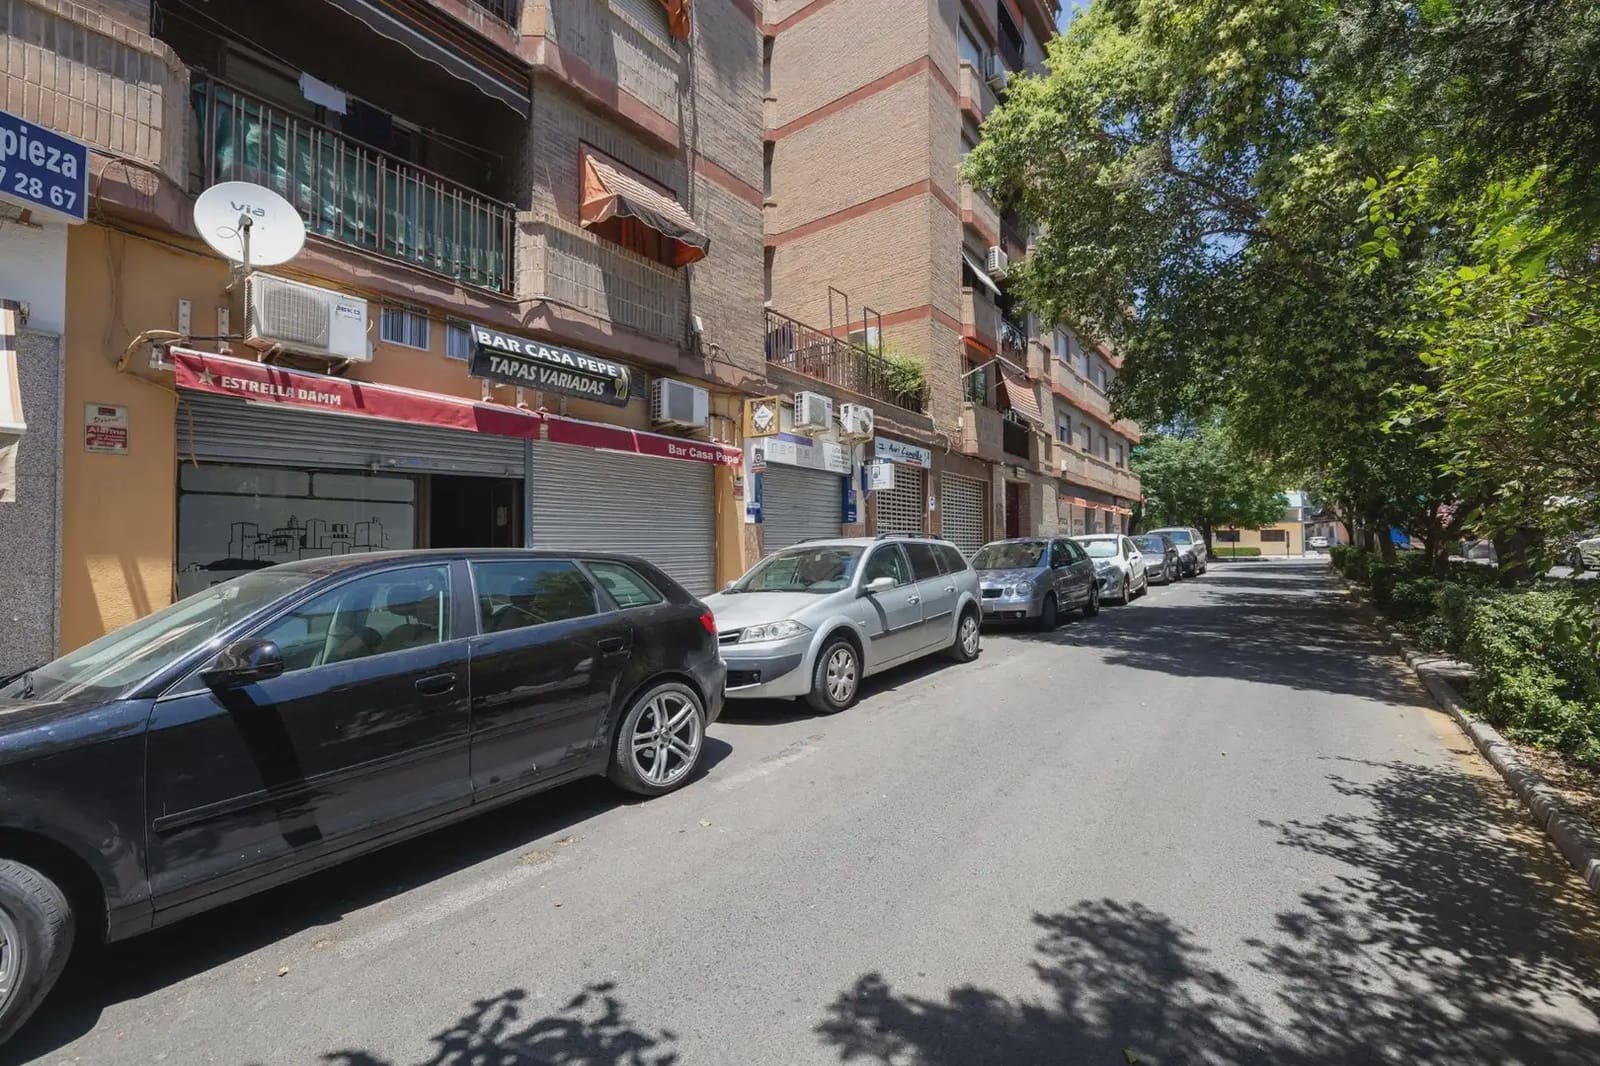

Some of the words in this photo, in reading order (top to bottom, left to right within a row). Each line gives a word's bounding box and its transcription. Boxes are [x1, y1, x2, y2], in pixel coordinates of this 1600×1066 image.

[0, 125, 77, 180] pieza
[14, 172, 43, 199] 28
[50, 185, 76, 210] 67
[477, 330, 521, 353] BAR
[524, 343, 575, 367] CASA
[577, 356, 618, 377] PEPE
[221, 375, 295, 399] ESTRELLA
[297, 389, 342, 405] DAMM
[490, 355, 537, 381] TAPAS
[540, 367, 605, 396] VARIADAS
[668, 443, 687, 456] Bar
[689, 447, 714, 460] Casa
[716, 450, 739, 465] Pepe
